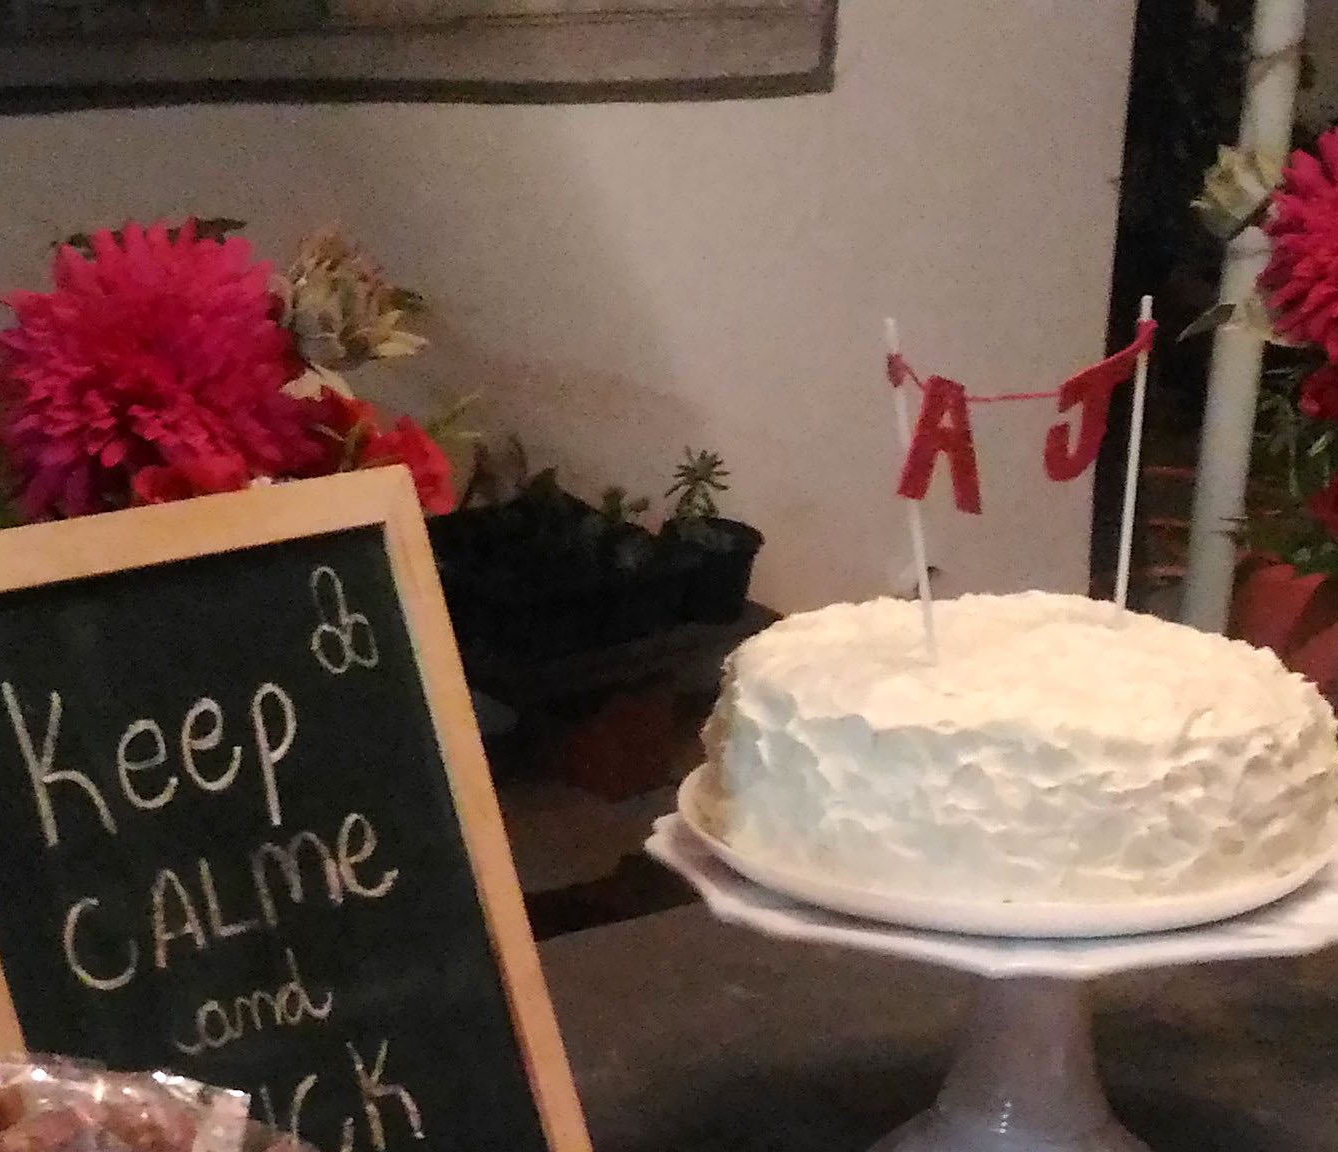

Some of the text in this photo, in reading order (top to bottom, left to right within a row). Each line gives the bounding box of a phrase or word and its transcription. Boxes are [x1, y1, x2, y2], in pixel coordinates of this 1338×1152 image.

[896, 348, 1139, 515] A J
[1, 681, 298, 848] Keep
[174, 946, 333, 1055] and
